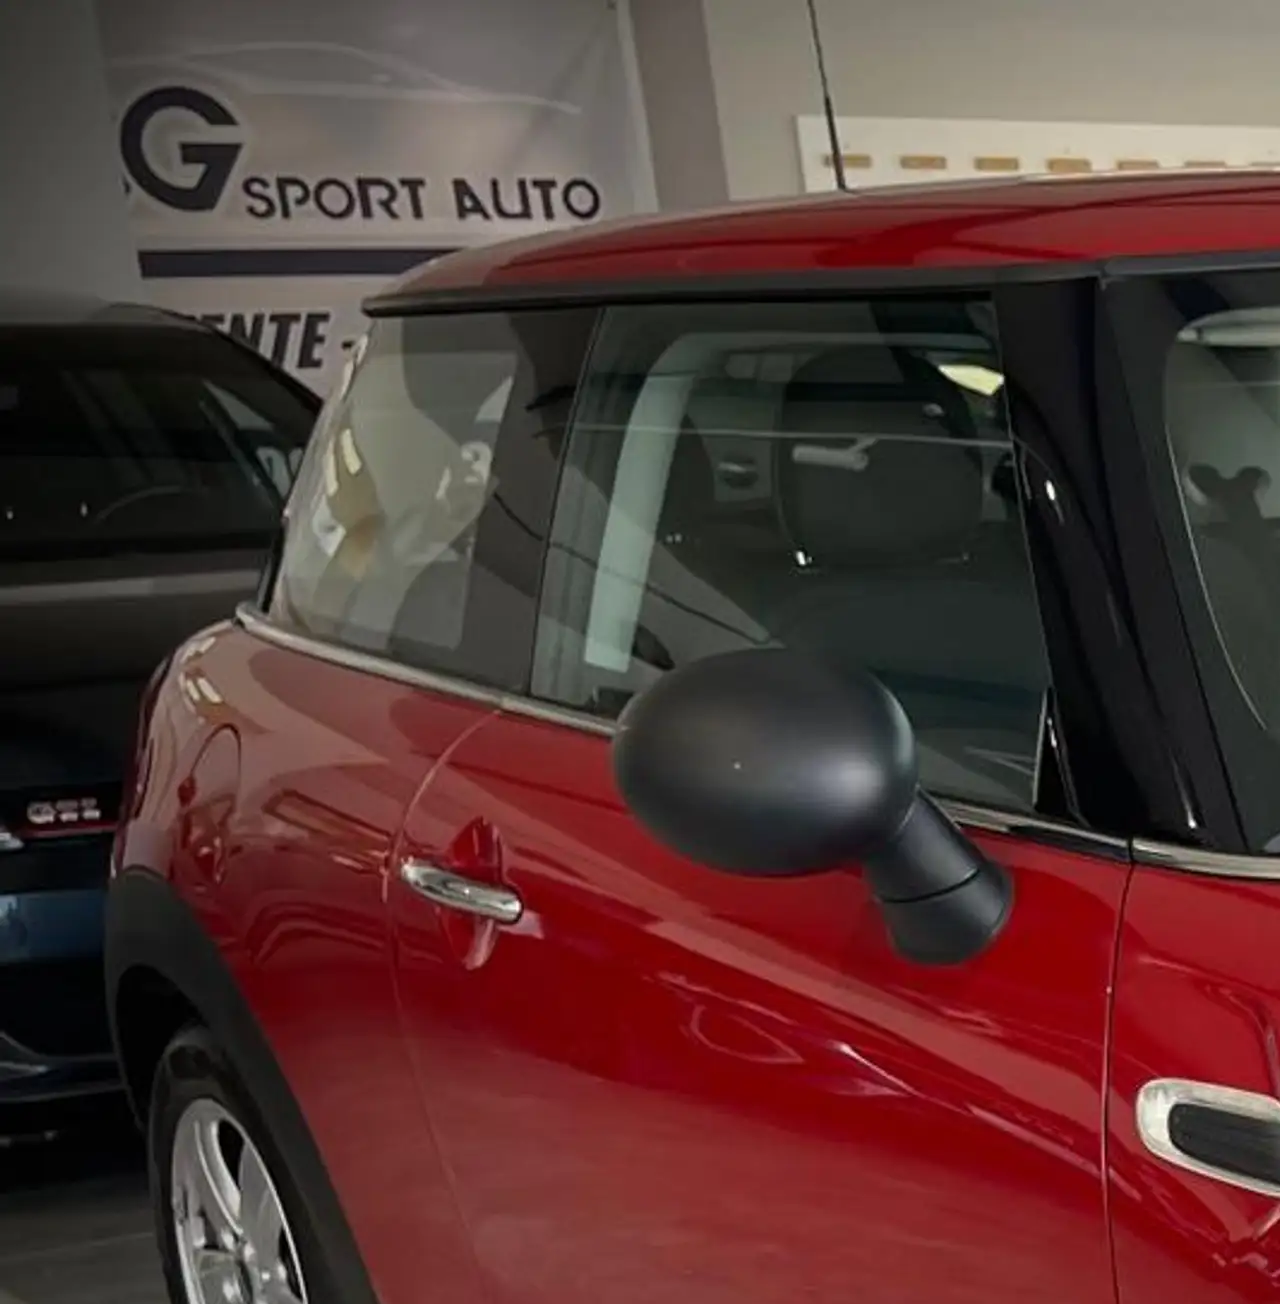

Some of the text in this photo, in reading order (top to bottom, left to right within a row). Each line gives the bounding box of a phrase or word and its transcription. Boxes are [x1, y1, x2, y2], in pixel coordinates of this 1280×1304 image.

[120, 86, 600, 220] G SPORT AUTO
